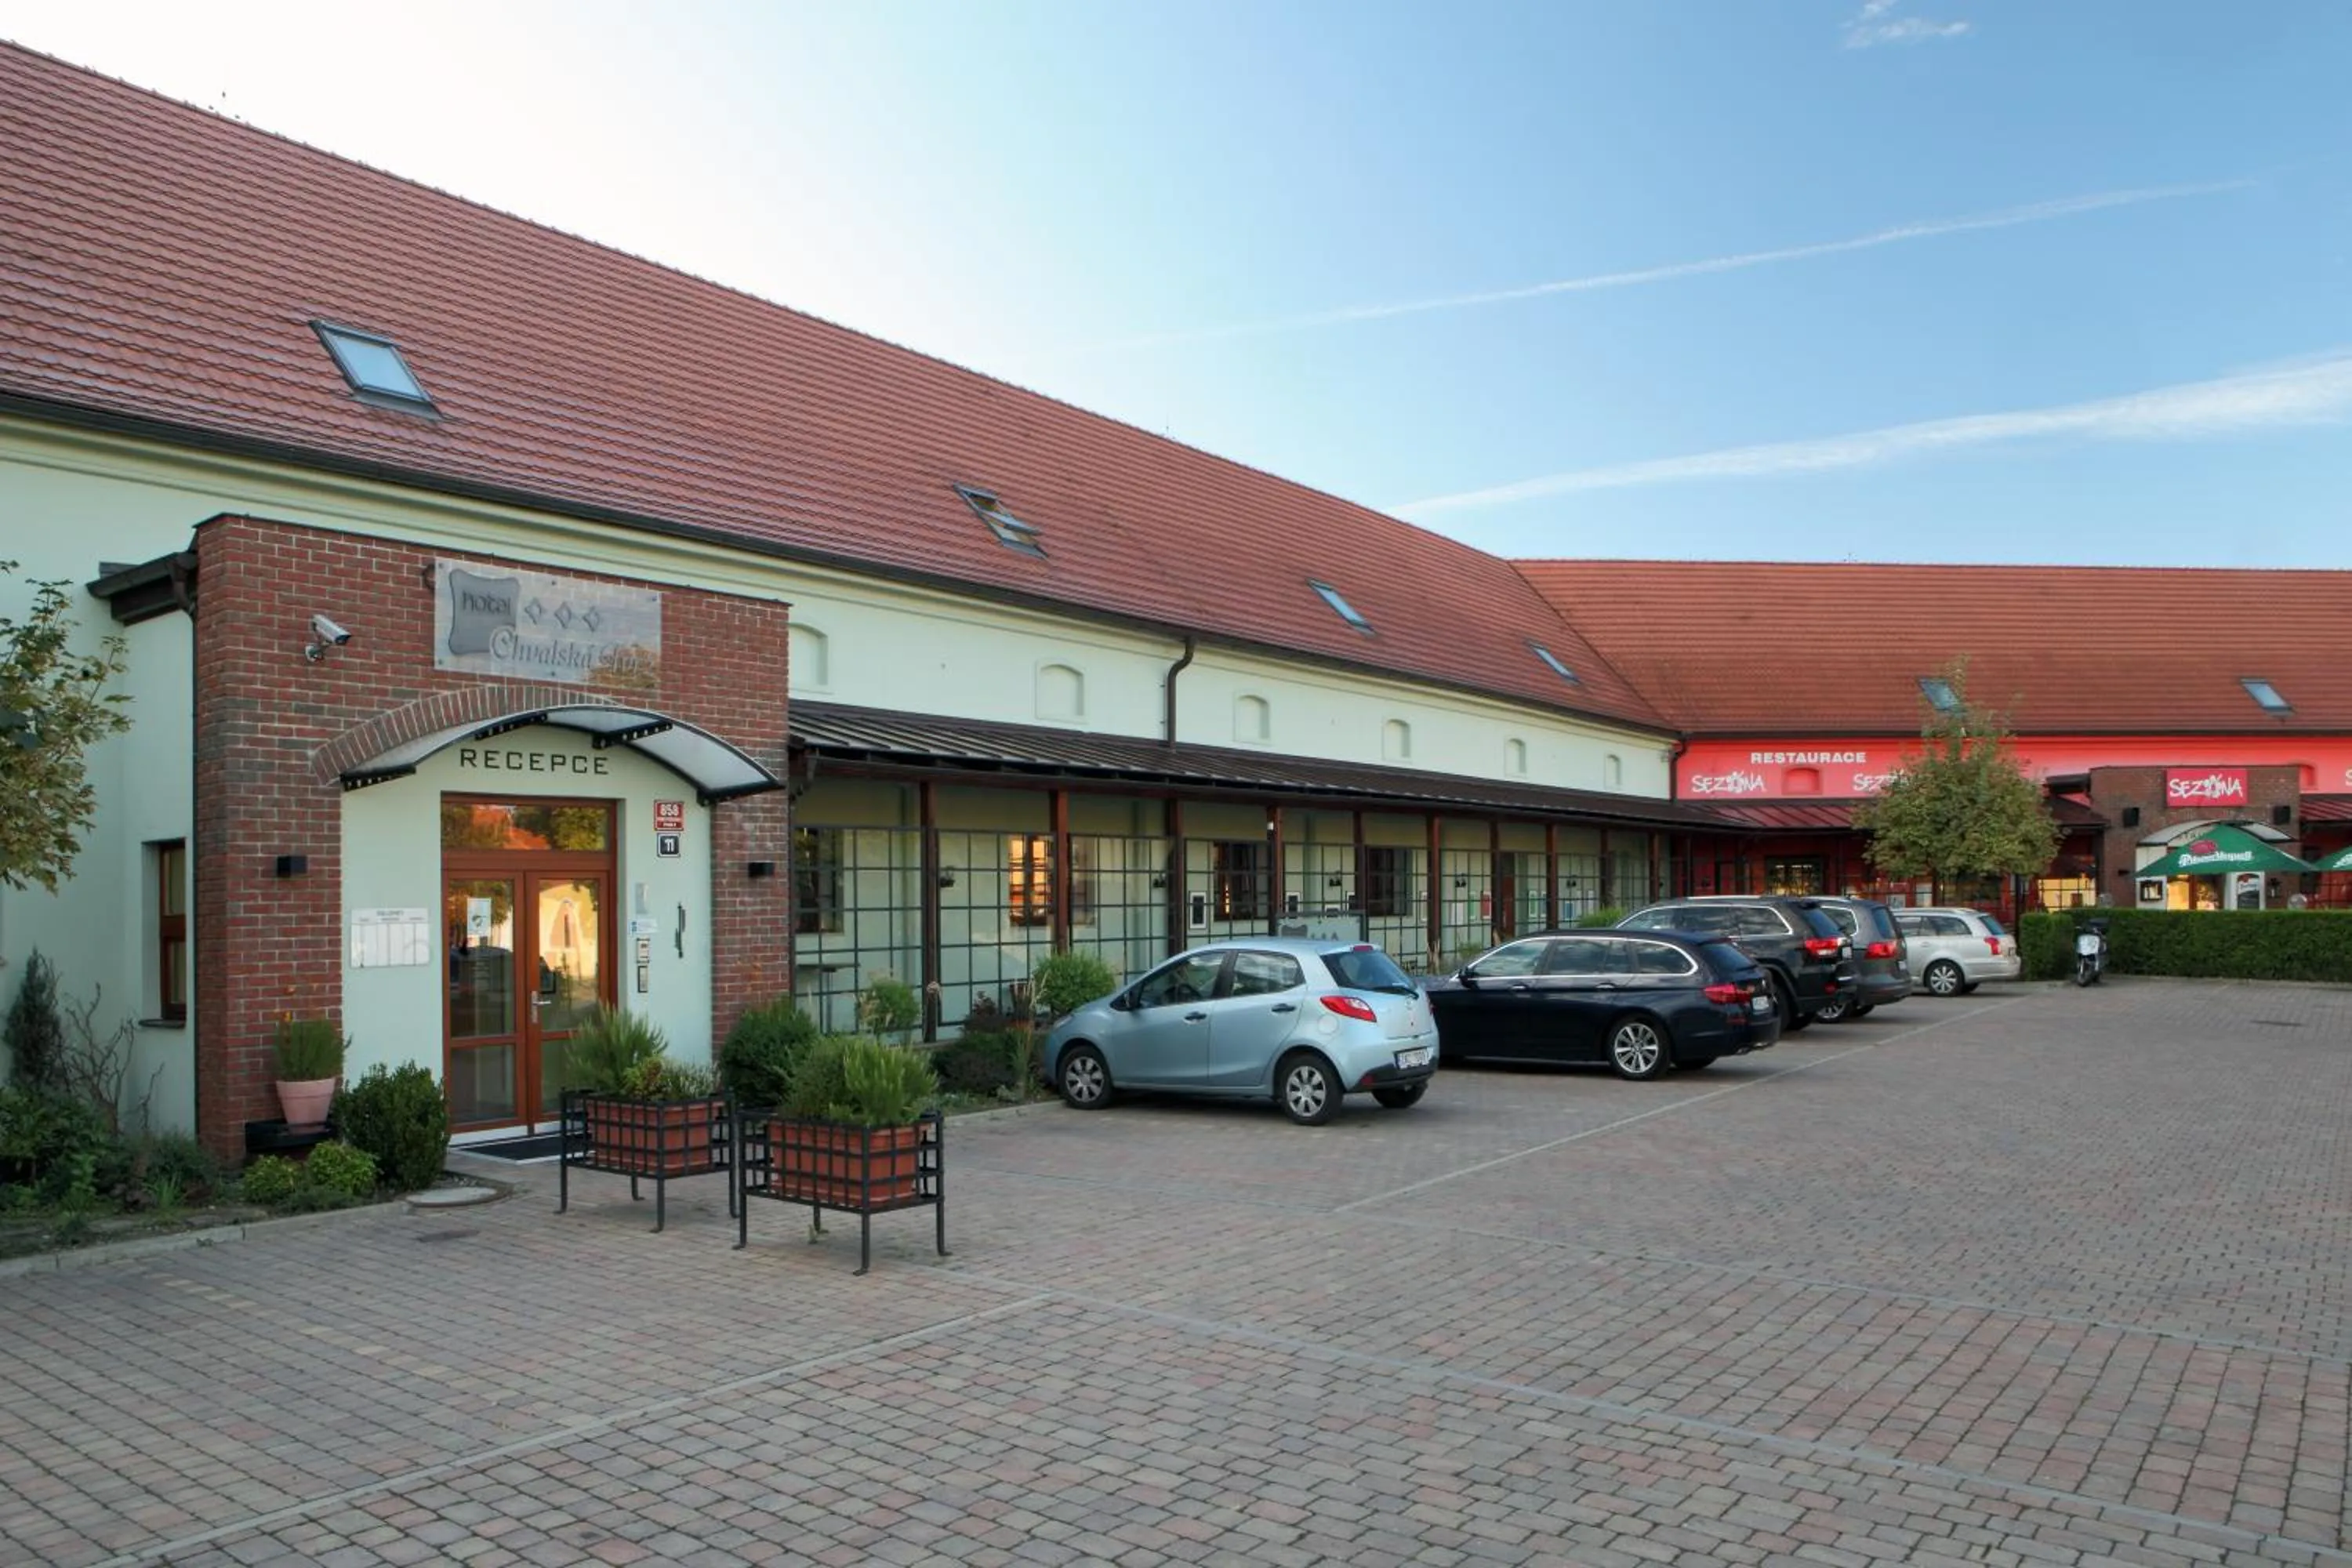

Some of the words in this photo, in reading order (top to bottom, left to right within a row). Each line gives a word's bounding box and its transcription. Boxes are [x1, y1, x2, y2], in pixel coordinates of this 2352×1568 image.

[459, 748, 609, 775] RECEPCE
[1751, 752, 1867, 764] RESTAURACE
[664, 838, 675, 852] 11
